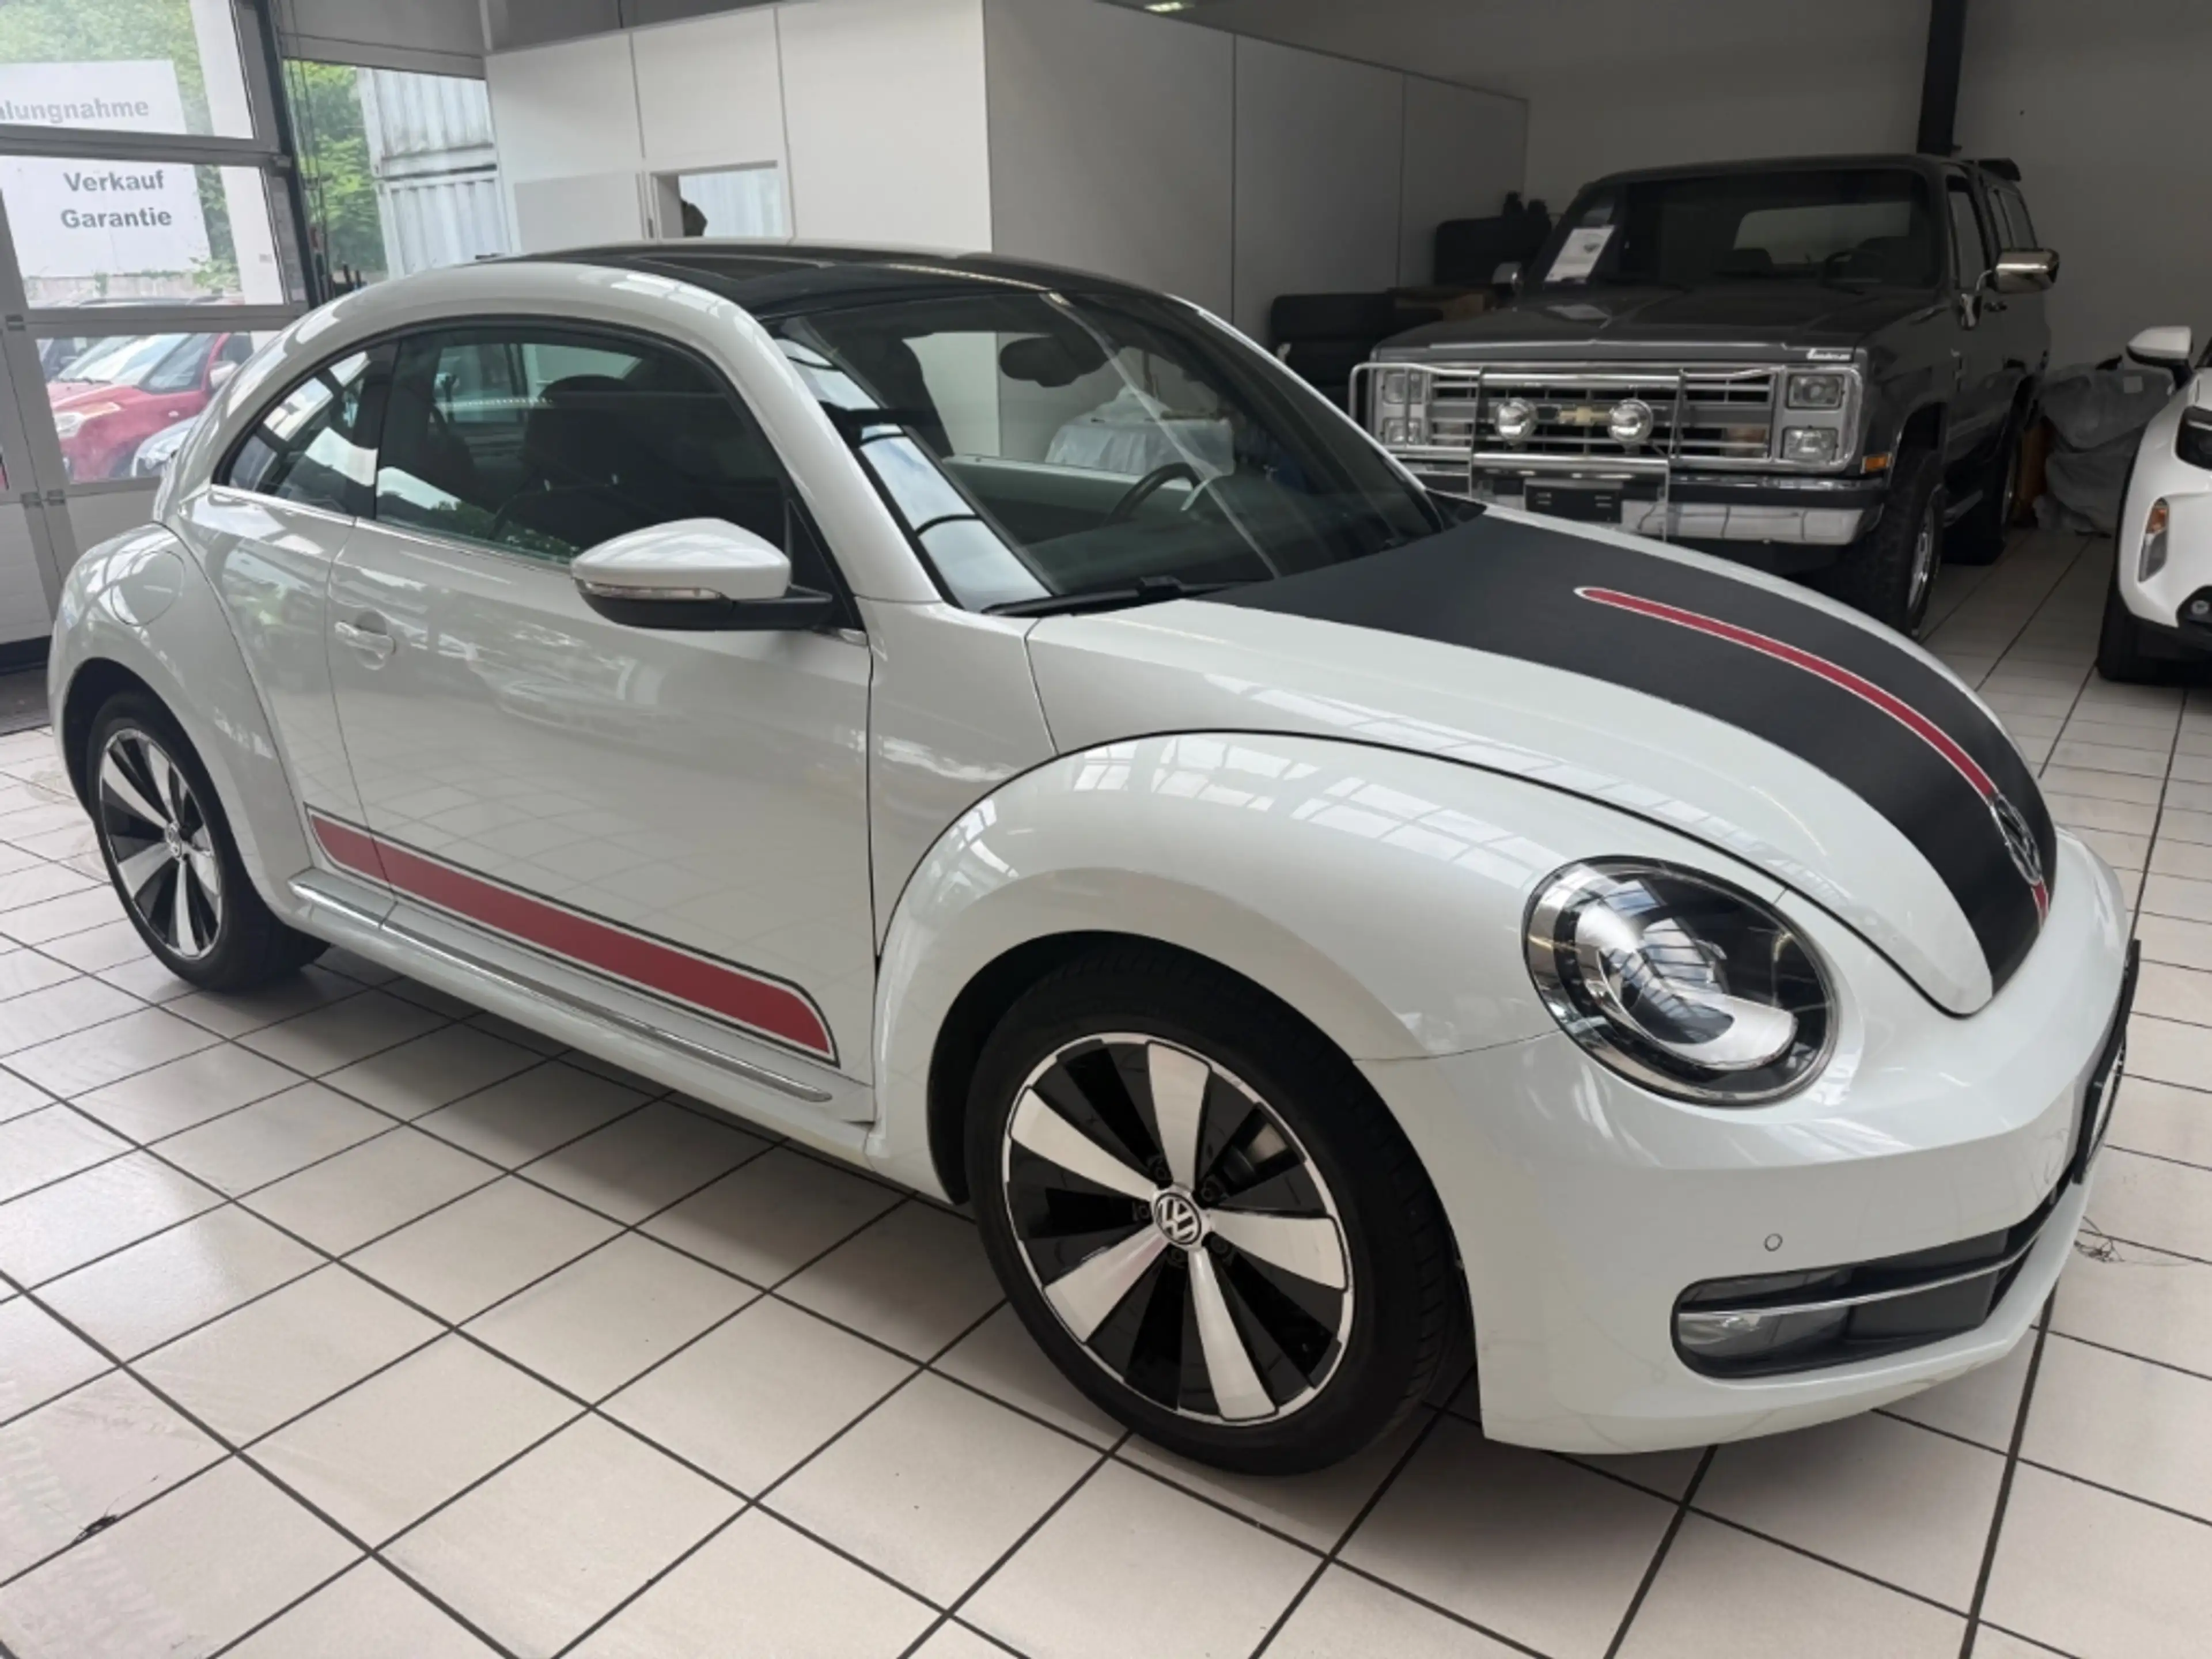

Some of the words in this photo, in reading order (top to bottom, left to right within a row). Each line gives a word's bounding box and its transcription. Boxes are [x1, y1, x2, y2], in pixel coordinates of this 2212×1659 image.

[63, 169, 164, 192] Verkauf
[60, 207, 172, 229] Garantie
[1156, 1195, 1199, 1243] VW
